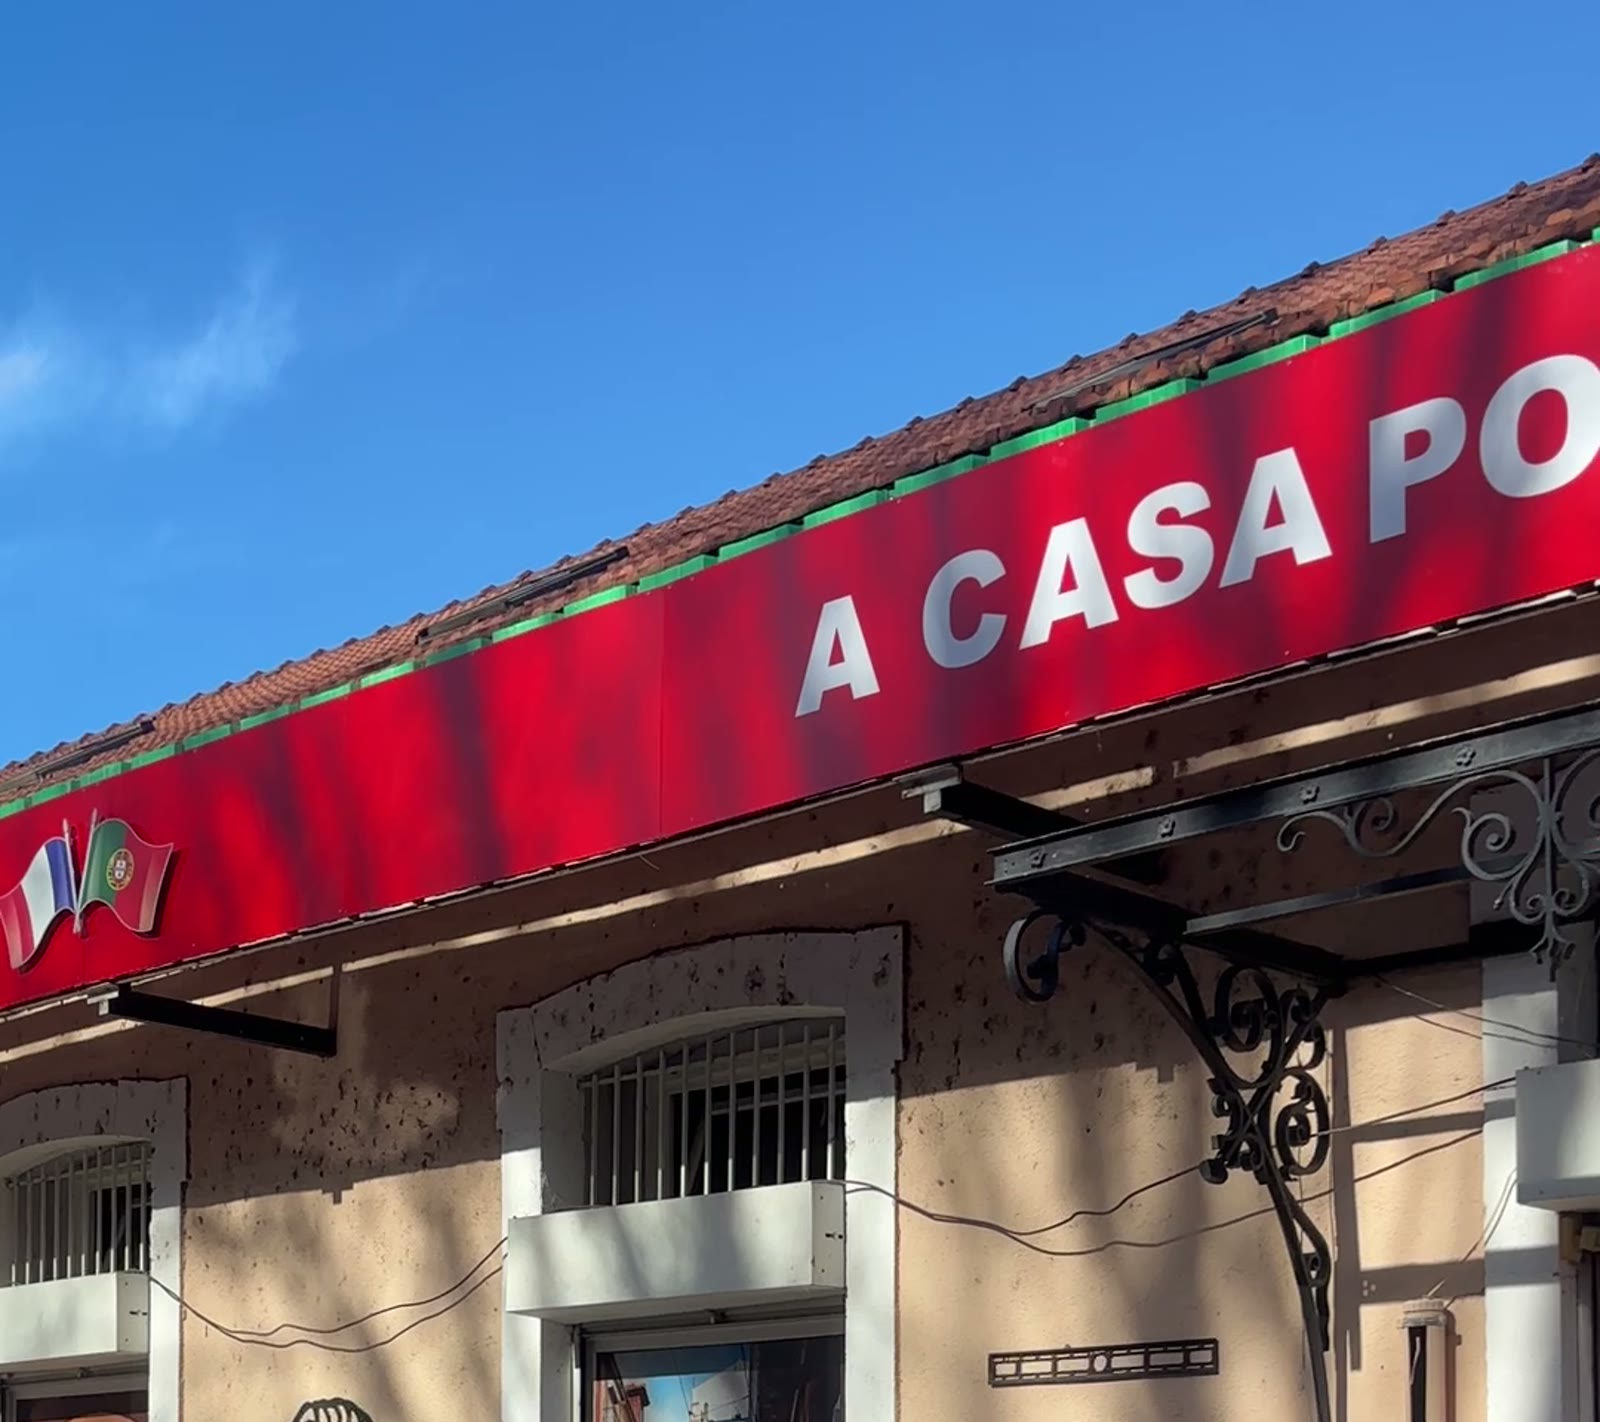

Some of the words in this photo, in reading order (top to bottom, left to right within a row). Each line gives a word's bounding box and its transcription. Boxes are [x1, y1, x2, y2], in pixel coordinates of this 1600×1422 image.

[795, 595, 880, 718] A
[923, 446, 1333, 670] CASA
[1369, 354, 1600, 544] PO
